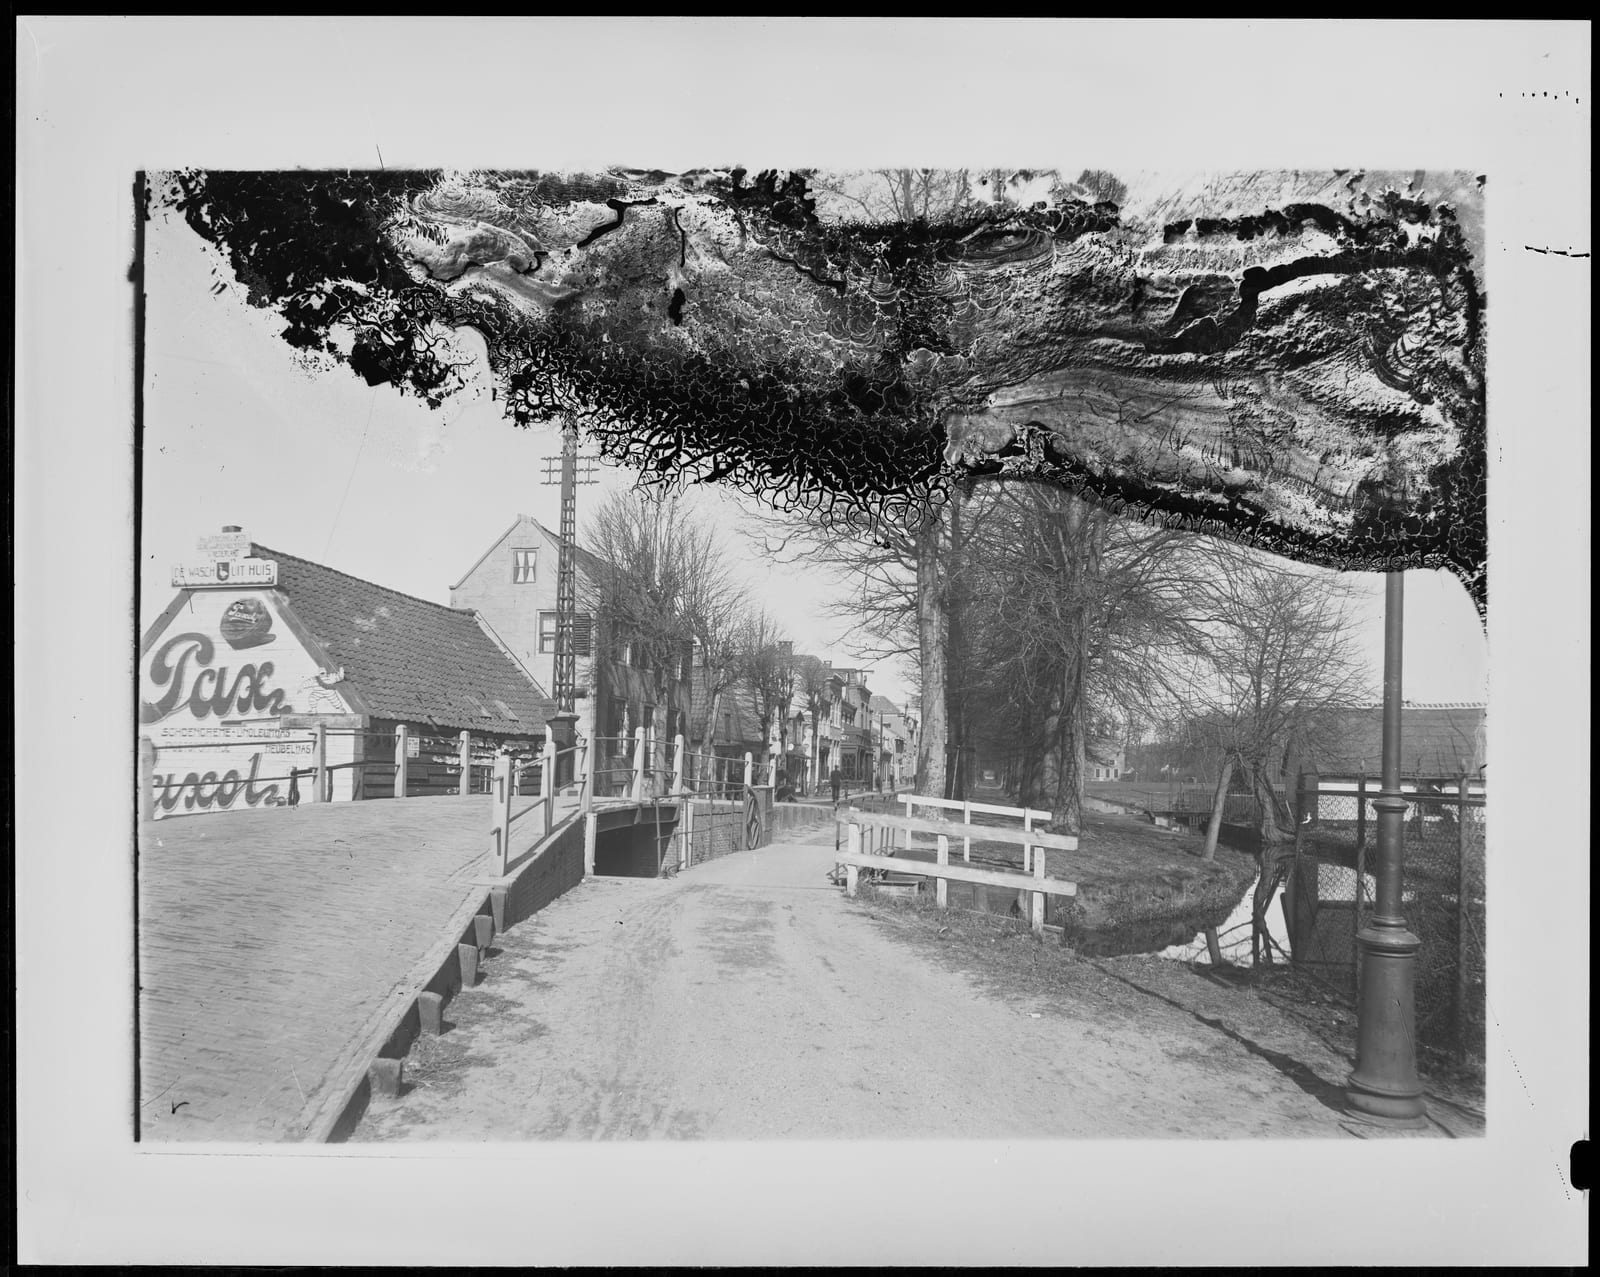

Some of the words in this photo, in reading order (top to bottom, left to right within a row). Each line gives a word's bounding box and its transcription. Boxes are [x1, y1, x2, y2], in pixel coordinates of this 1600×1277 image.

[189, 566, 215, 578] WASCH
[249, 564, 272, 576] HUIS
[141, 631, 293, 725] Pax
[151, 752, 287, 811] axol
